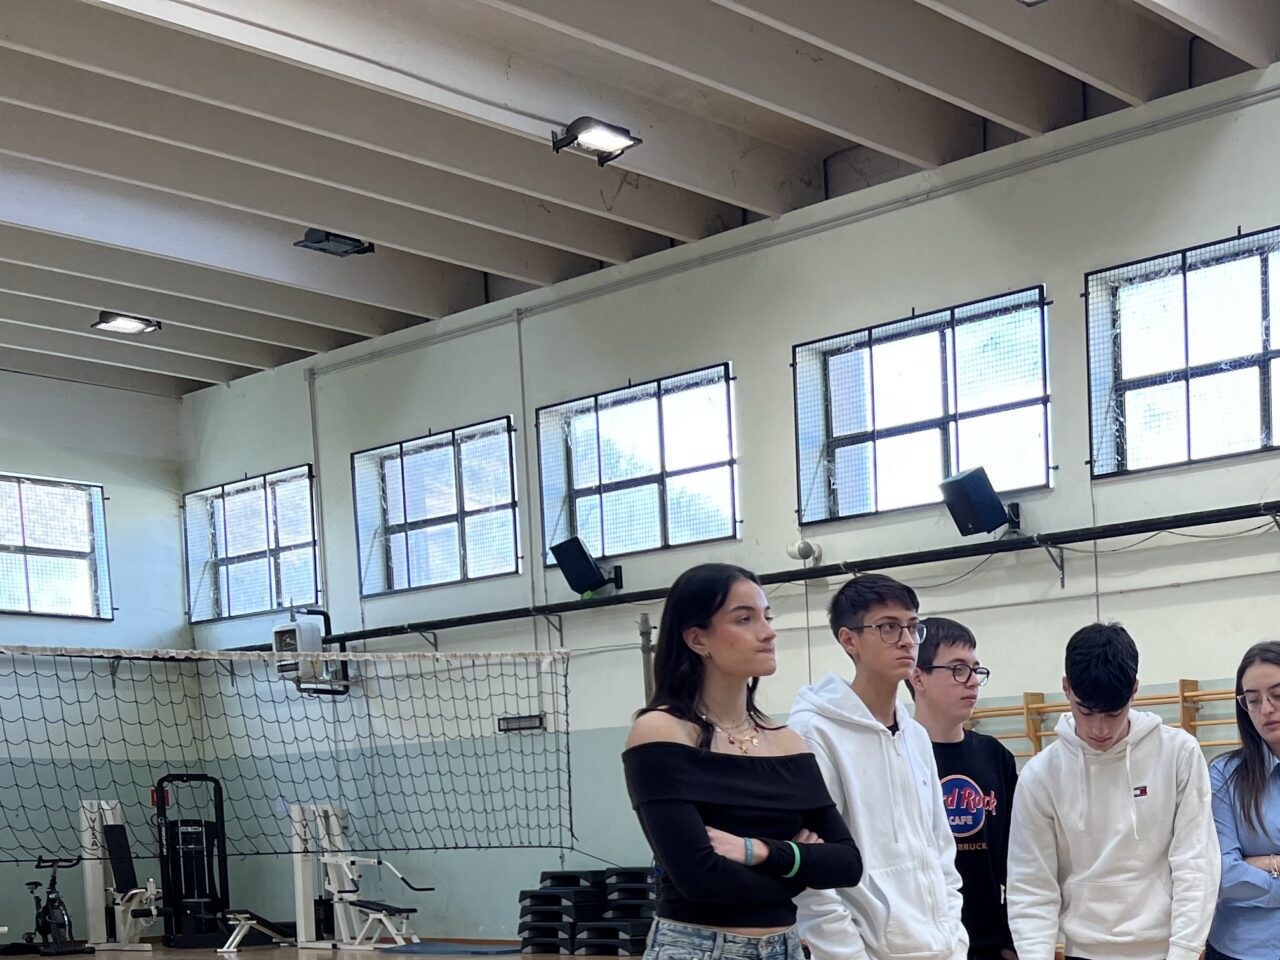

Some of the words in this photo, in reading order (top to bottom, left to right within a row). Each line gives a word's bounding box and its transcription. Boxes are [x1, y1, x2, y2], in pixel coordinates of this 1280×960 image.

[961, 787, 997, 815] Rock
[949, 815, 973, 825] CAFE
[957, 842, 988, 850] BRUCK
